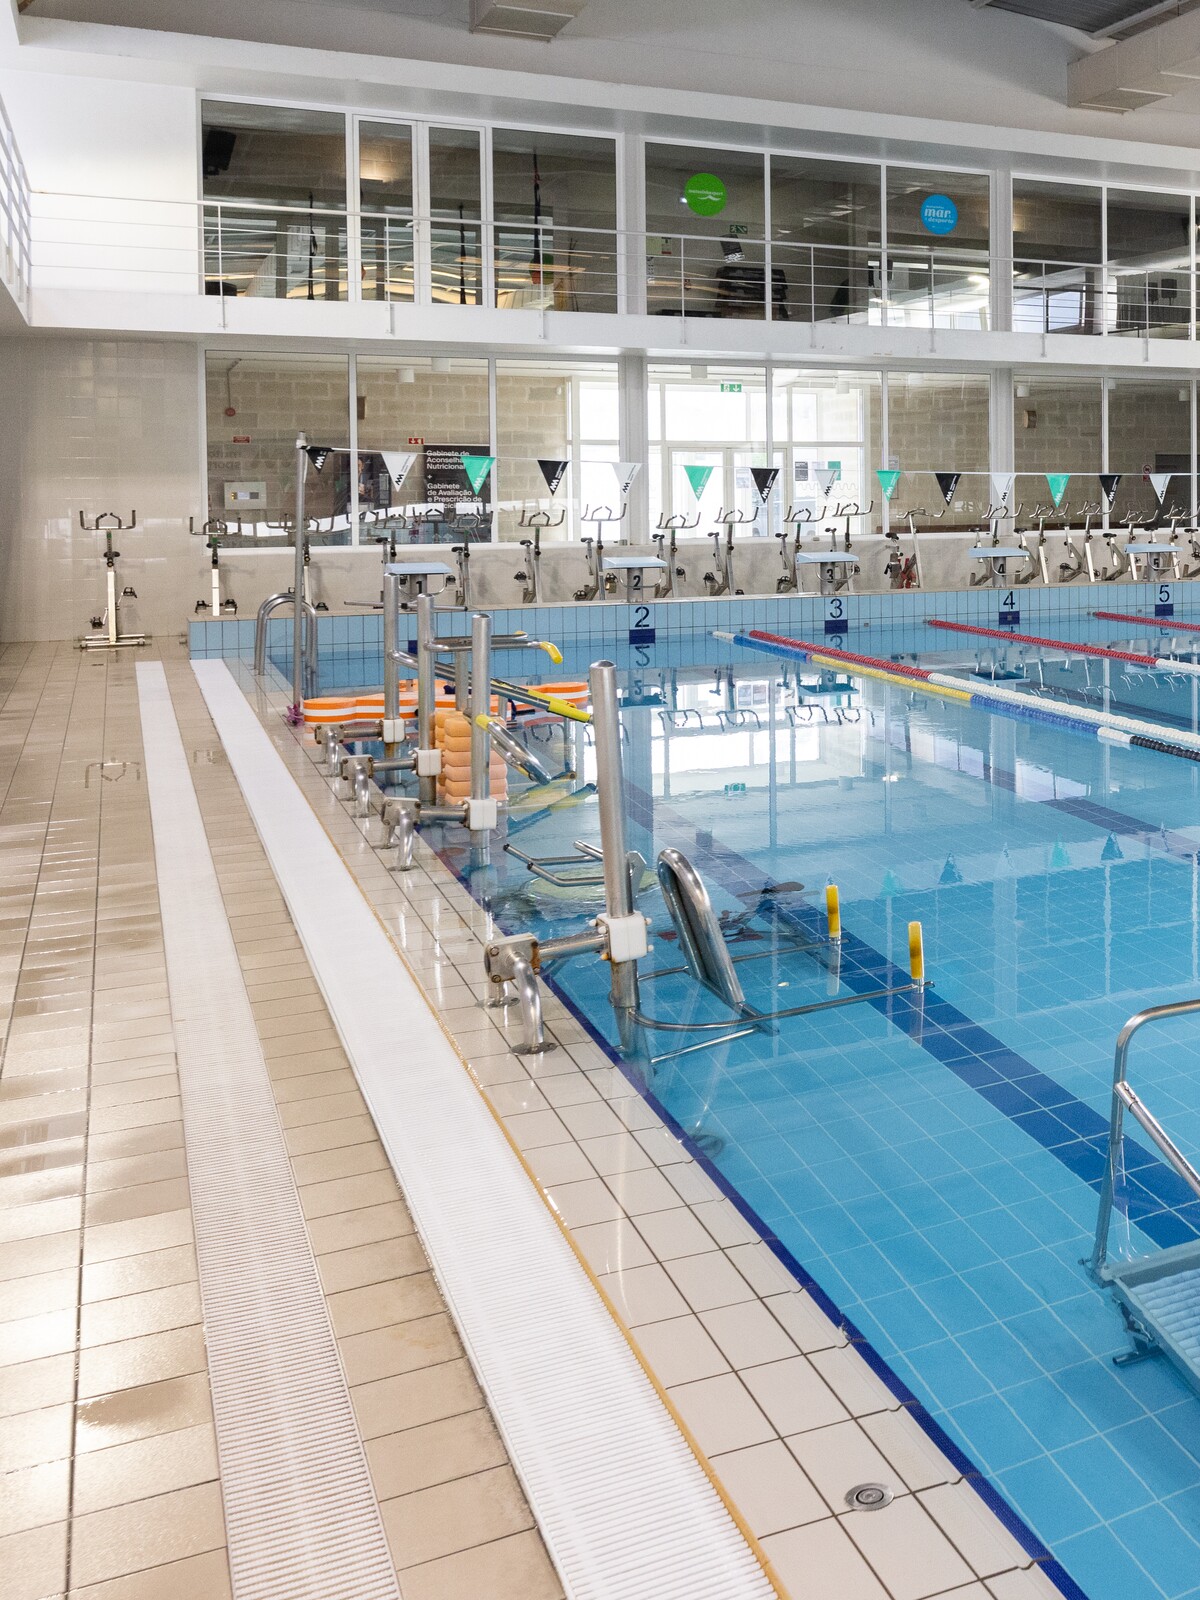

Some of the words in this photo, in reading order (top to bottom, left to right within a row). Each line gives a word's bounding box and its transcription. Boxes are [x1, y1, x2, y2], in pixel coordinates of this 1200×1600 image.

[826, 568, 834, 583] 3
[998, 564, 1005, 577] 4
[416, 581, 422, 594] 1
[633, 575, 641, 590] 2
[1003, 591, 1016, 609] 4
[1159, 585, 1170, 602] 5
[830, 598, 843, 618] 3
[635, 606, 650, 627] 2
